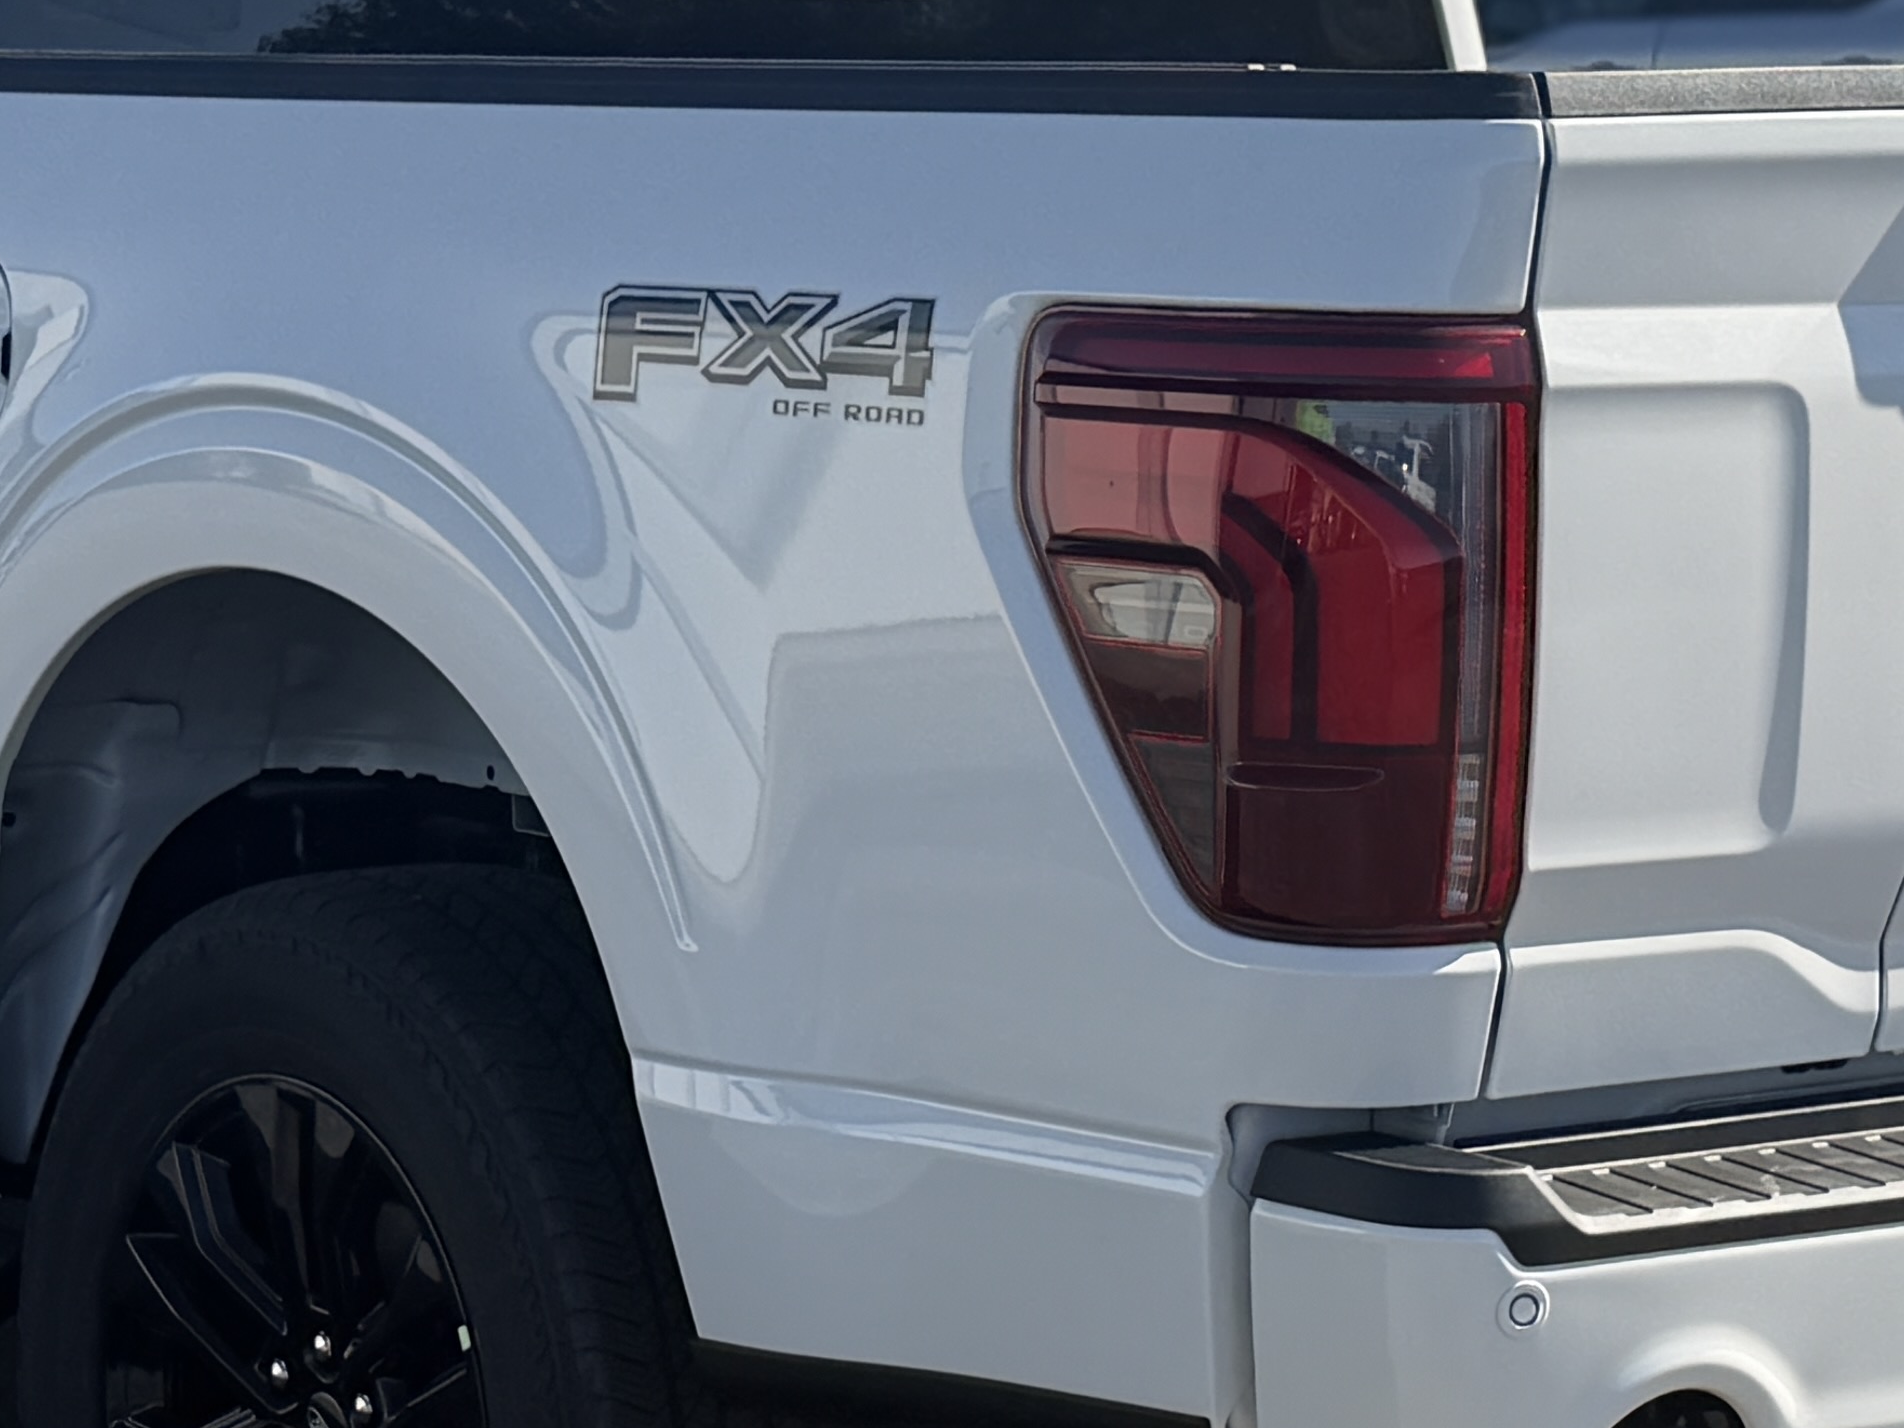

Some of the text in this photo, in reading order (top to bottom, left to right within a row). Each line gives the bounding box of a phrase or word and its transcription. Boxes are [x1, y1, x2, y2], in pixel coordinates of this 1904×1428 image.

[593, 284, 936, 403] FX4
[772, 398, 925, 426] OFF ROAD
